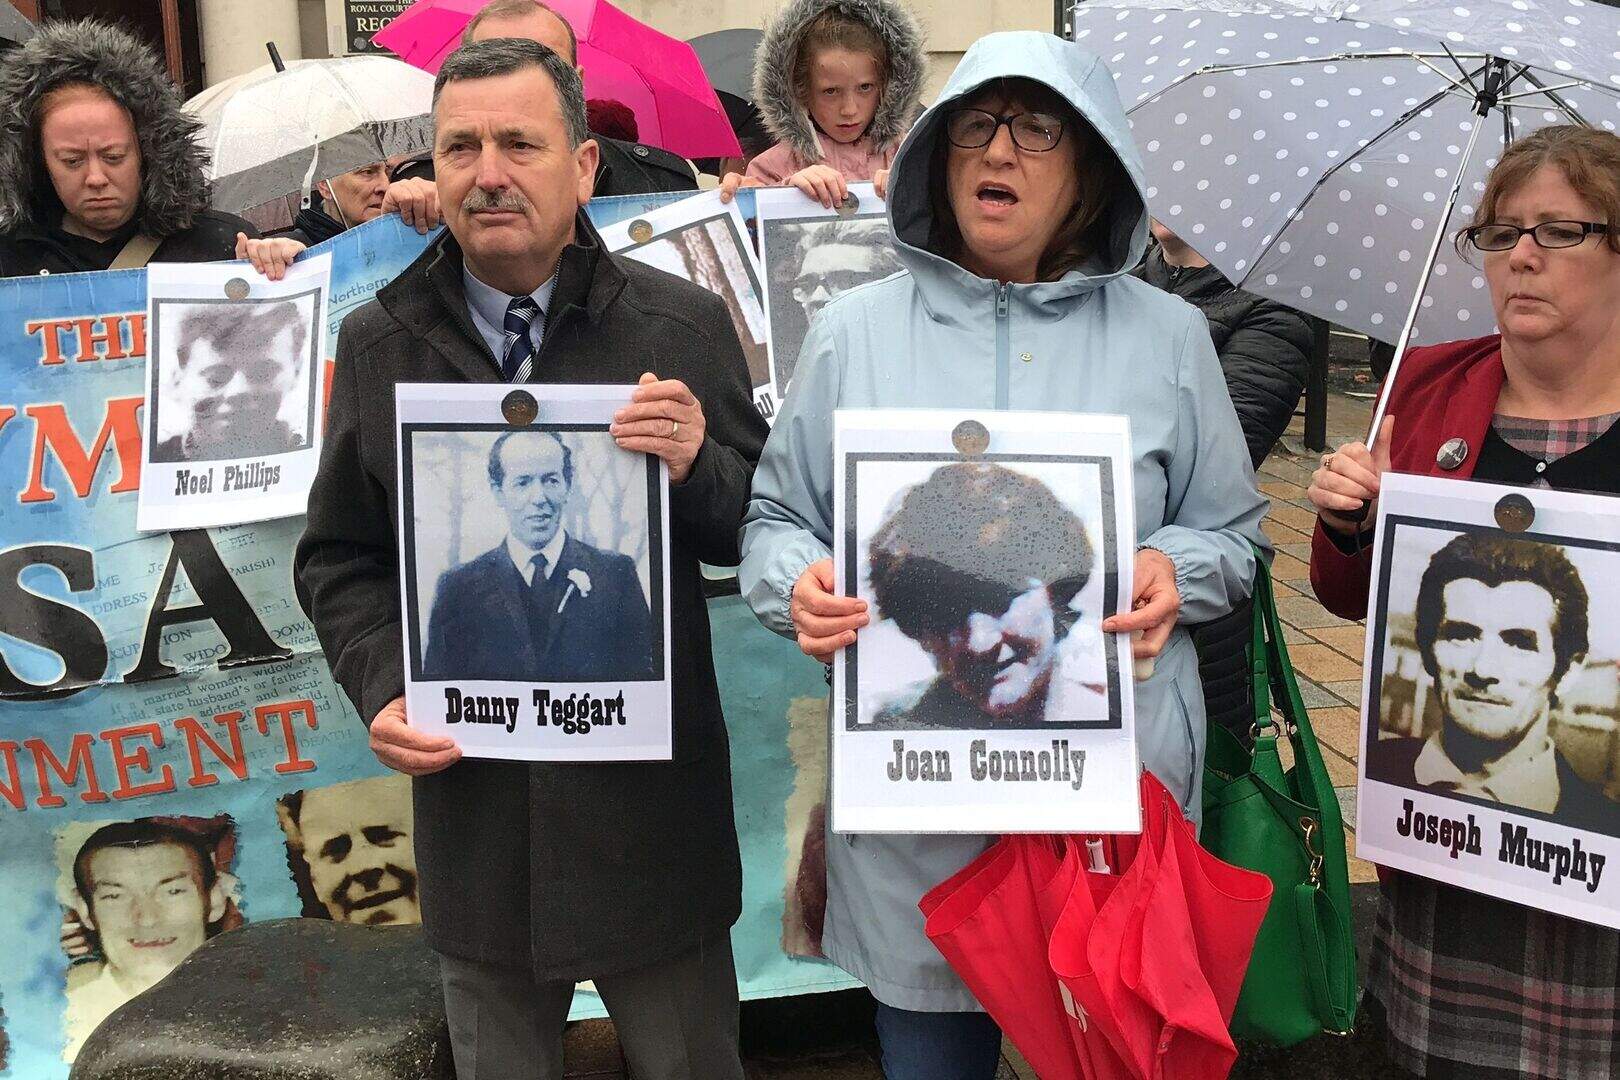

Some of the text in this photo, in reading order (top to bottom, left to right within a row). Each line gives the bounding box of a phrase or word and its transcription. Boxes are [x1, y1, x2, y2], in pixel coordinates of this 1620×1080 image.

[350, 5, 410, 13] ROYAL COURT
[356, 17, 397, 32] REC
[174, 461, 281, 496] Noel Phillips
[92, 592, 149, 615] DDRESS
[183, 643, 227, 662] WIDO
[144, 686, 193, 706] married
[252, 660, 293, 678] widow
[299, 656, 313, 665] or
[187, 685, 250, 707] husband's
[253, 680, 267, 691] or
[271, 666, 320, 686] father's
[255, 689, 280, 703] and
[288, 680, 323, 694] occu-
[444, 687, 627, 735] Danny Teggart
[886, 739, 1087, 791] Joan Connolly
[1396, 798, 1606, 893] Joseph Murphy
